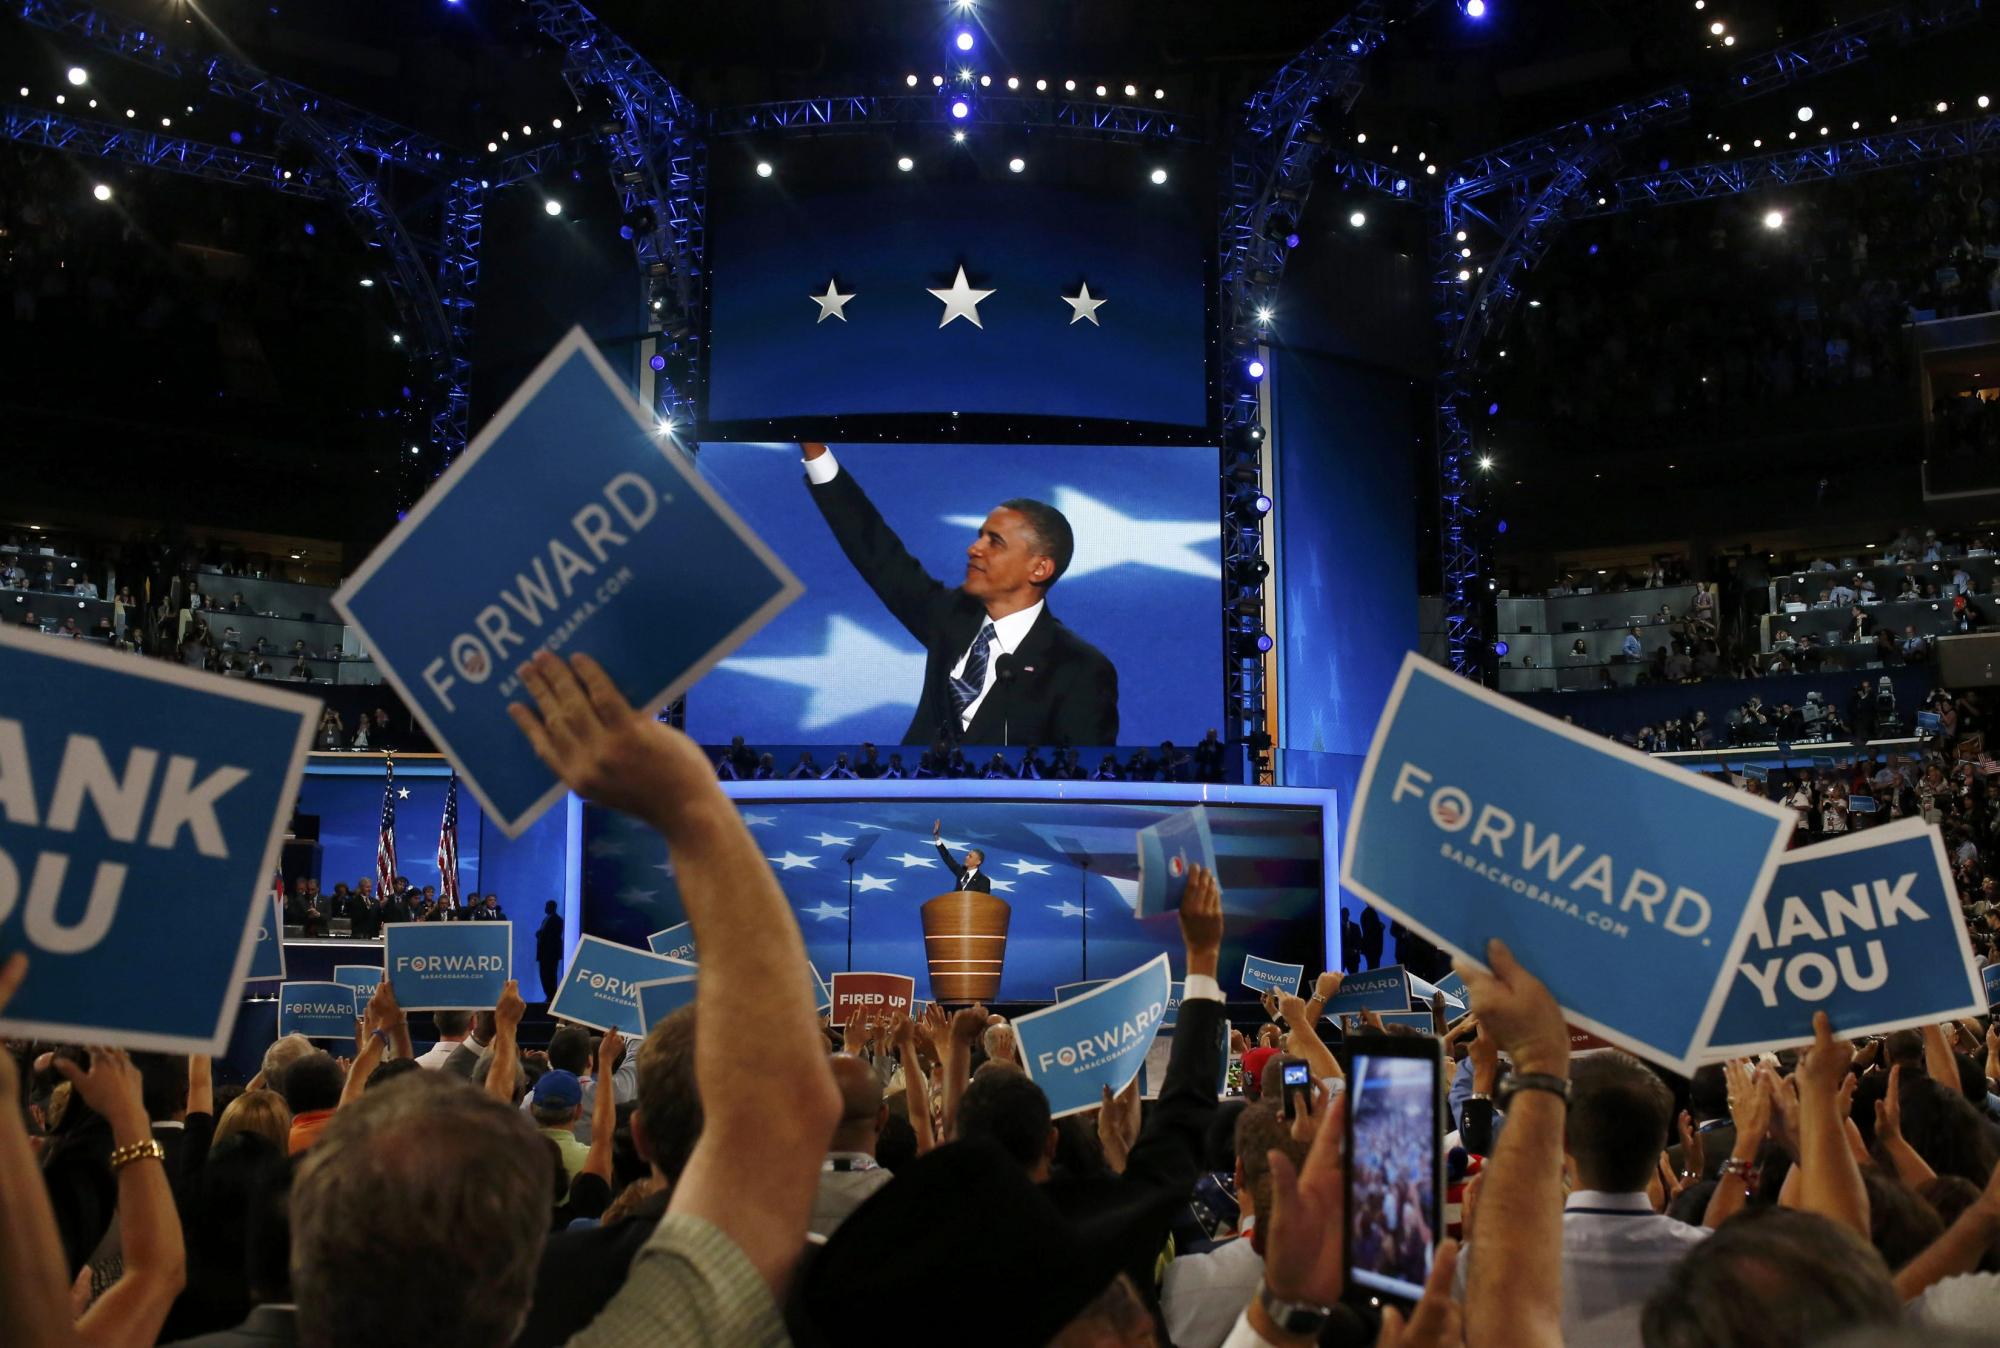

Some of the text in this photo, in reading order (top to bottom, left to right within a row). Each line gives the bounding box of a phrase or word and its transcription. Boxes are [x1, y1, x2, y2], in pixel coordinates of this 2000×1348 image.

[422, 472, 674, 712] FORWARD.
[1392, 762, 1712, 946] FORWARD.
[1440, 843, 1630, 938] BARACKOBAMA.COM
[576, 969, 638, 998] FORW
[840, 994, 907, 1008] FIRED UP
[1738, 940, 1889, 1008] YOU
